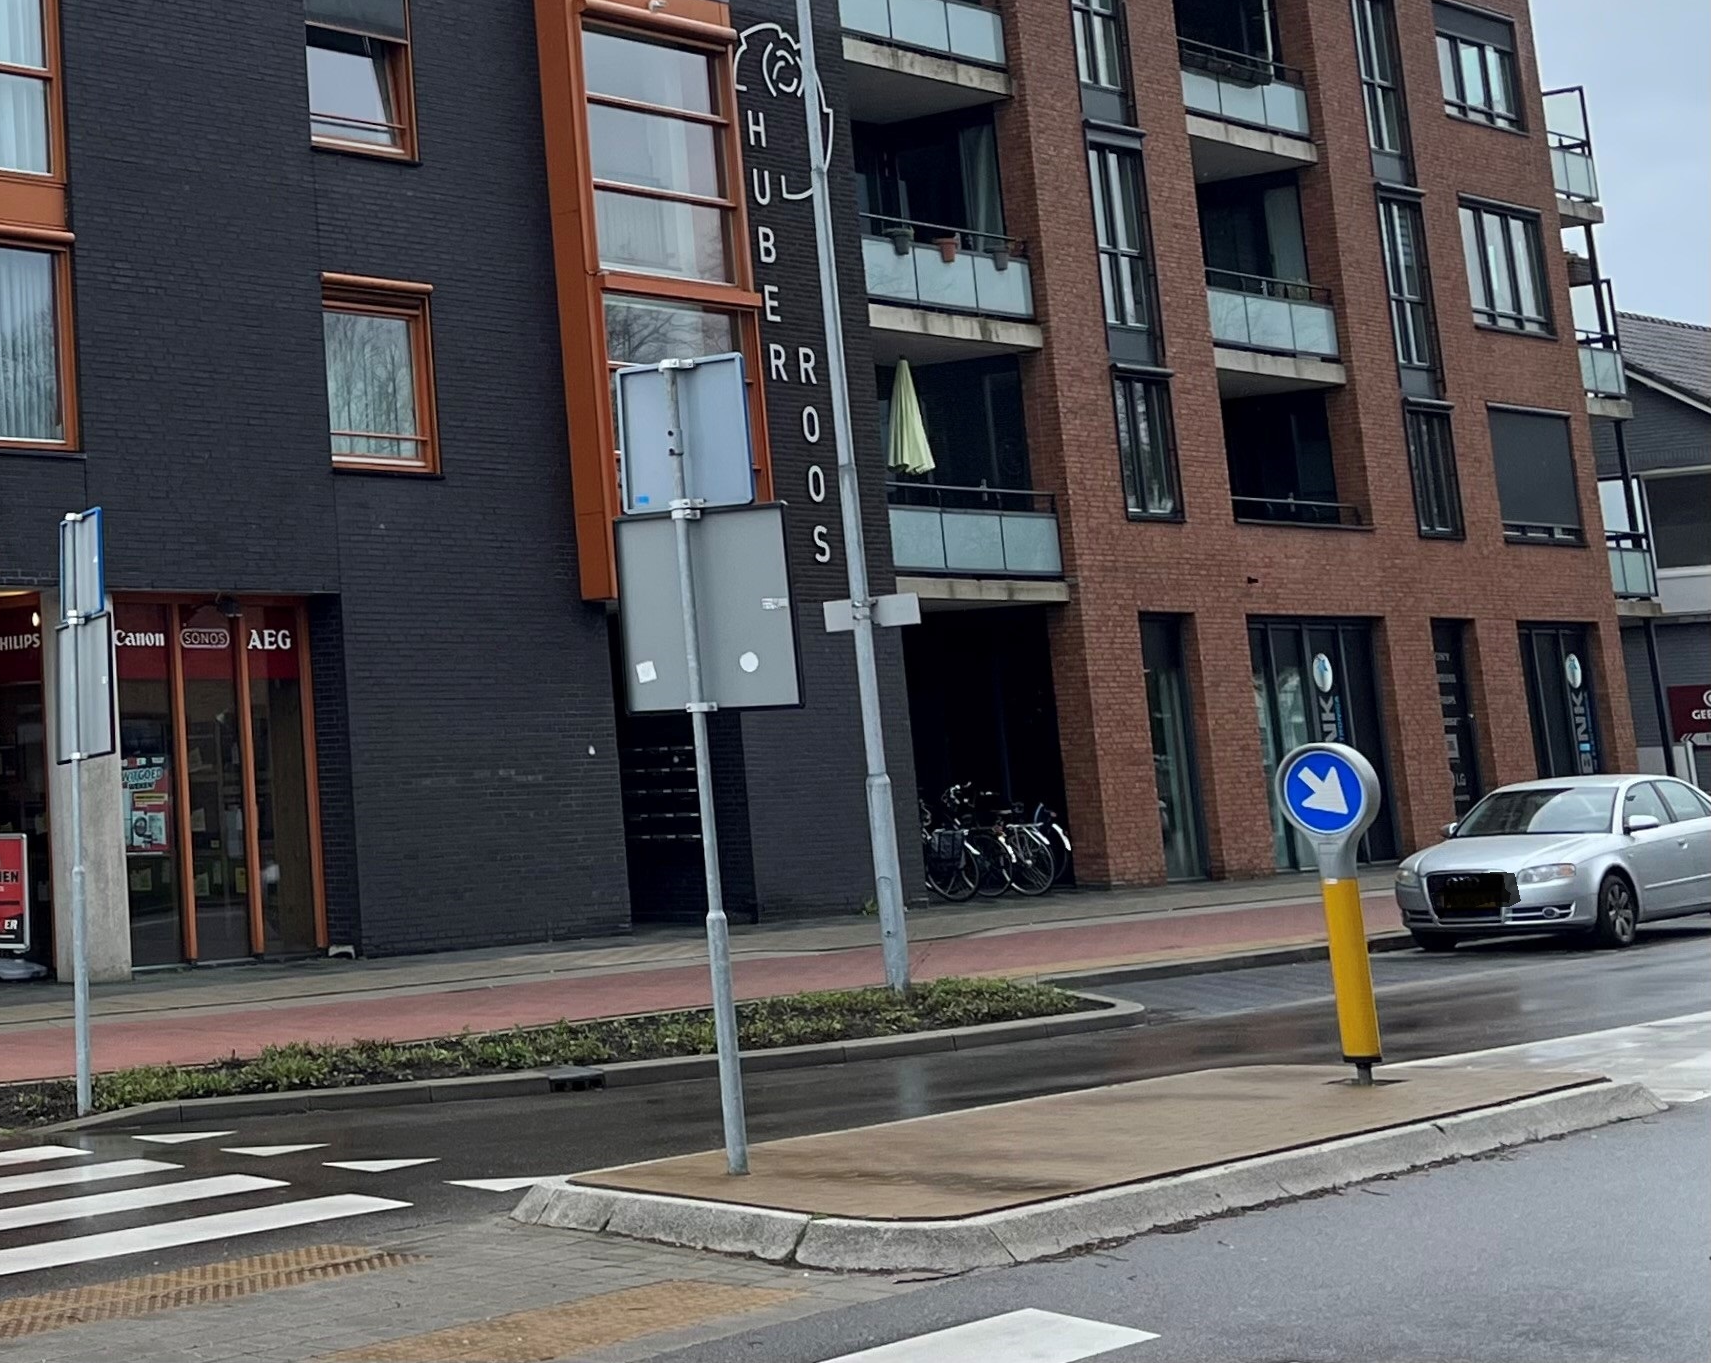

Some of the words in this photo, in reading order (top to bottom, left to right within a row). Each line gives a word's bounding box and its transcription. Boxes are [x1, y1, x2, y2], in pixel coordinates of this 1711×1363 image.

[798, 346, 832, 564] ROOS
[114, 629, 166, 647] Canon
[183, 631, 227, 645] SONOS
[247, 629, 292, 650] AEG
